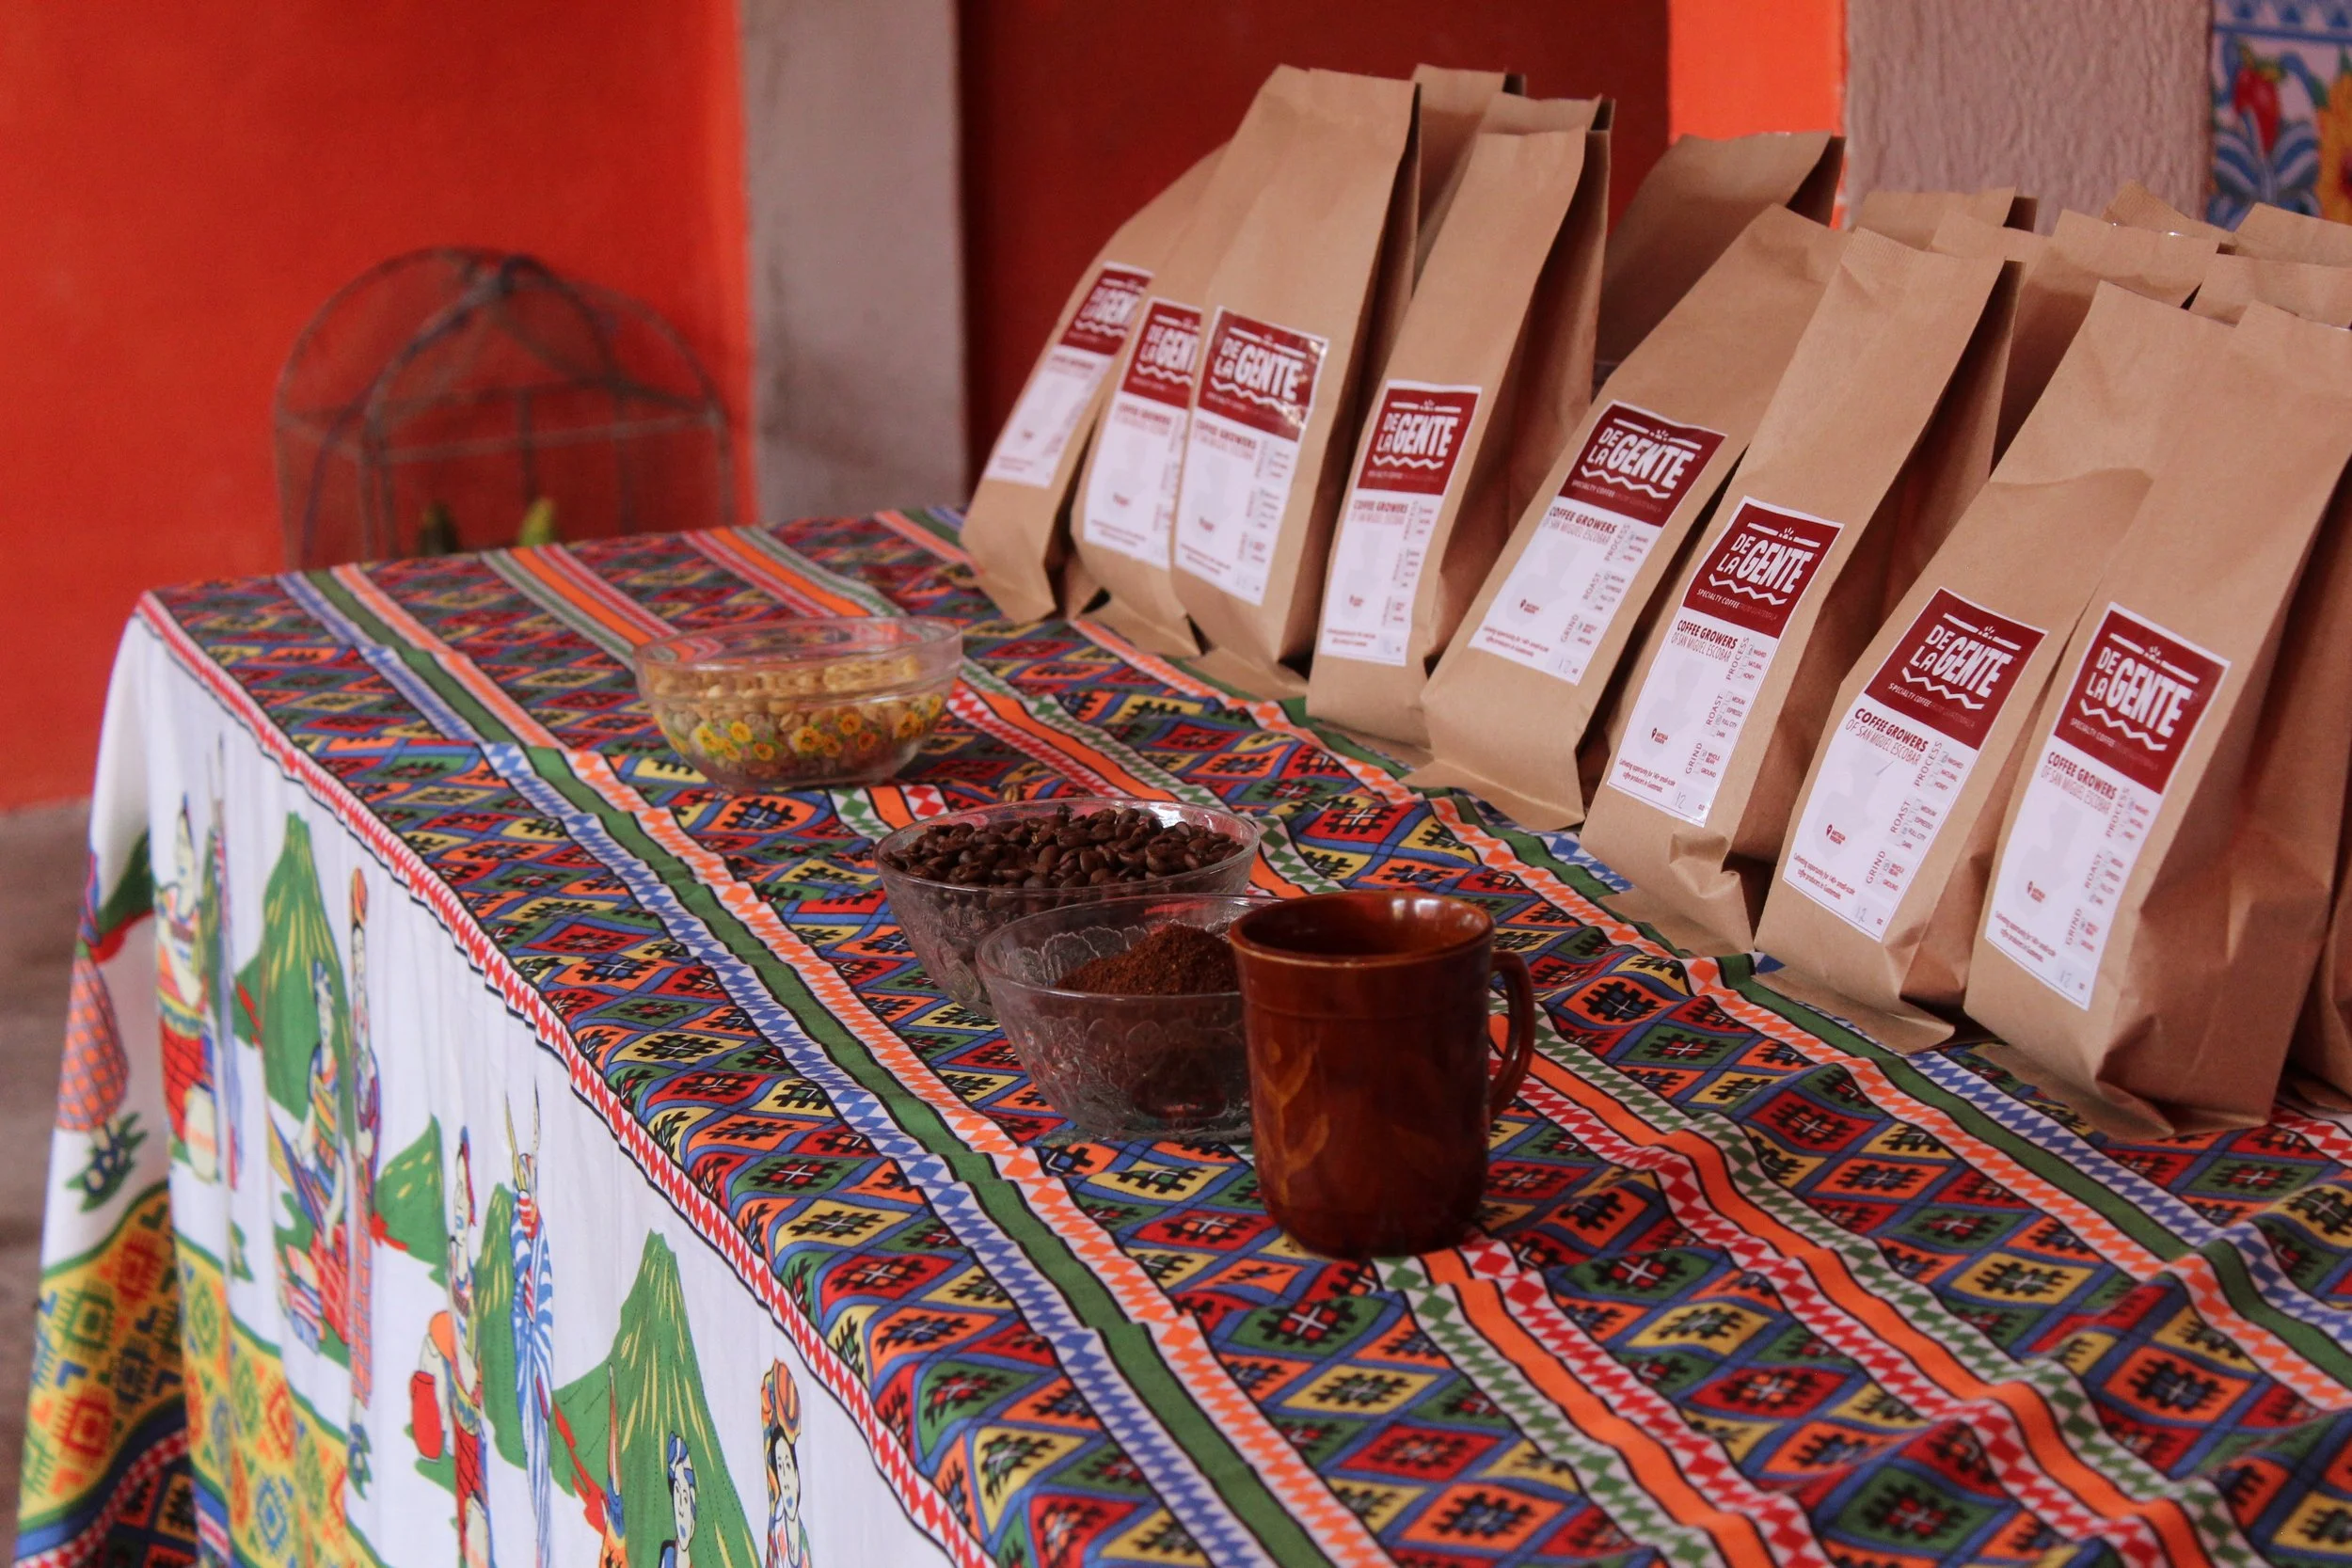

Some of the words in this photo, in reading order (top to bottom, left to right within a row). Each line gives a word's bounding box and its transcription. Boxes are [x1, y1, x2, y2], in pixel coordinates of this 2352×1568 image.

[1147, 324, 1166, 342] DE
[1221, 338, 1243, 358] DE
[1139, 342, 1157, 362] LA
[1156, 327, 1199, 372] GENT
[1214, 356, 1235, 379] LA
[1234, 344, 1304, 402] GENTE
[1375, 434, 1393, 452] LA
[1392, 413, 1459, 457] GENTE
[1383, 413, 1401, 432] DE
[1598, 427, 1623, 447] DE
[1586, 445, 1608, 466] LA
[1607, 434, 1695, 489] GENTE
[1549, 506, 1575, 521] COFFEE
[1575, 515, 1617, 534] GROWERS
[1604, 524, 1630, 562] PROCESS
[1730, 533, 1756, 555] DE
[1716, 553, 1740, 575] LA
[1737, 539, 1814, 594] GENTE
[1582, 572, 1601, 600] ROAST
[1697, 589, 1723, 602] SPECIALTY
[1722, 596, 1740, 609] COFFEE
[1561, 613, 1579, 643] GRIND
[1677, 620, 1701, 637] COFFEE
[1700, 627, 1739, 650] GROWERS
[1925, 624, 1956, 650] DE
[1671, 632, 1679, 644] OF
[1678, 634, 1688, 648] SAN
[1686, 637, 1707, 656] MIGUEL
[1706, 642, 1732, 663] ESCOBAR
[1725, 637, 1750, 681] PROCESS
[2096, 646, 2122, 674] DE
[1910, 645, 1938, 672] LA
[1931, 636, 2013, 698] GENTE
[1706, 694, 1724, 725] ROAST
[1888, 683, 1916, 700] SPECIALTY
[1914, 695, 1932, 707] COFFEE
[2085, 672, 2108, 701] LA
[2106, 657, 2193, 738] GENTE
[1846, 719, 1857, 731] OF
[1857, 725, 1872, 741] SAN
[1869, 731, 1892, 751] MIGUEL
[1890, 740, 1921, 767] ESCOBAR
[1854, 707, 1888, 733] COFFEE
[1886, 723, 1929, 752] GROWERS
[1685, 742, 1703, 774] GRIND
[1915, 741, 1943, 787] PROCESS
[2048, 752, 2076, 778] COFFEE
[2077, 768, 2118, 800] GROWERS
[1890, 800, 1911, 833] ROAST
[1866, 850, 1885, 884] GRIND
[2084, 852, 2104, 889] ROAST
